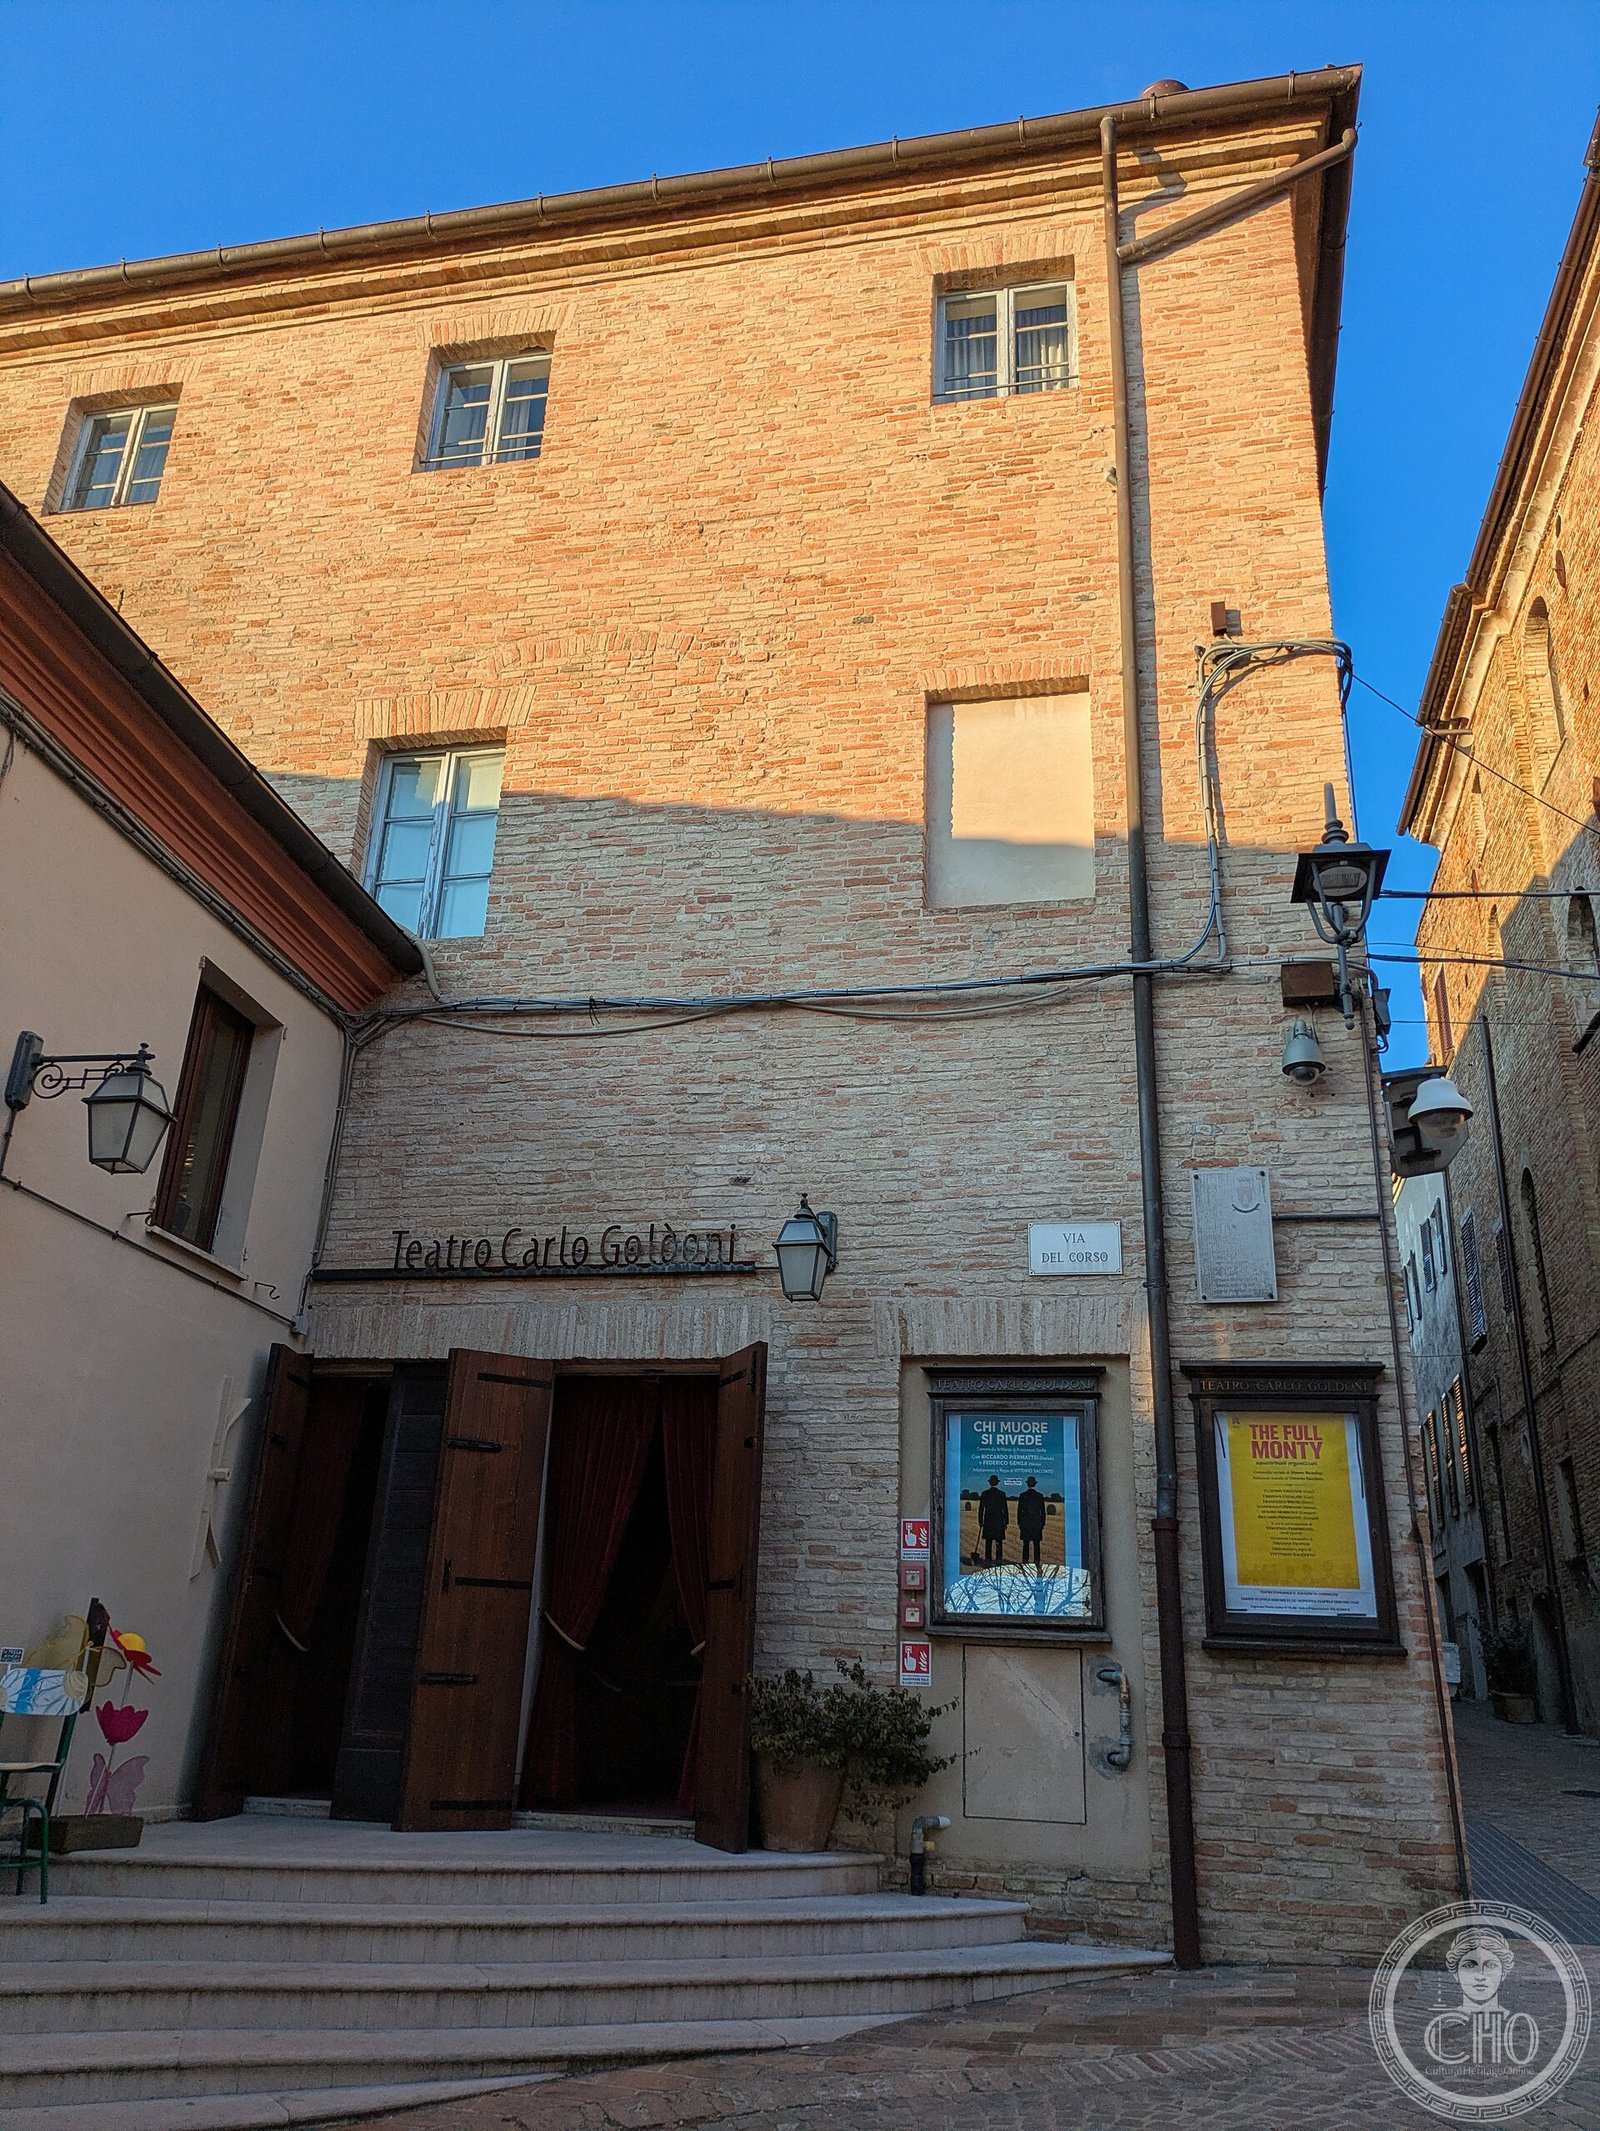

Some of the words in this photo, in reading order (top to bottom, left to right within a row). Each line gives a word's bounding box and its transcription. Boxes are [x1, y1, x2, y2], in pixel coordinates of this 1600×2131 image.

[1062, 1232, 1087, 1243] VIA
[392, 1230, 492, 1271] Teatro
[500, 1225, 589, 1269] Carlo
[600, 1222, 737, 1266] Goldoni
[1041, 1252, 1065, 1263] DEL
[1068, 1251, 1109, 1262] CORSO
[936, 1379, 984, 1390] TEATRO
[987, 1379, 1031, 1390] CARLO
[1033, 1379, 1092, 1390] GOLDONI
[1200, 1380, 1249, 1391] TEATRO
[1256, 1380, 1301, 1391] CARLO
[1307, 1380, 1367, 1392] GOLDONI
[973, 1420, 996, 1433] CHI
[1000, 1421, 1048, 1434] MUORE
[1248, 1423, 1279, 1441] THE
[1282, 1424, 1323, 1441] FULL
[981, 1433, 992, 1445] SI
[997, 1434, 1043, 1446] RIVEDE
[1250, 1440, 1323, 1460] MONTY
